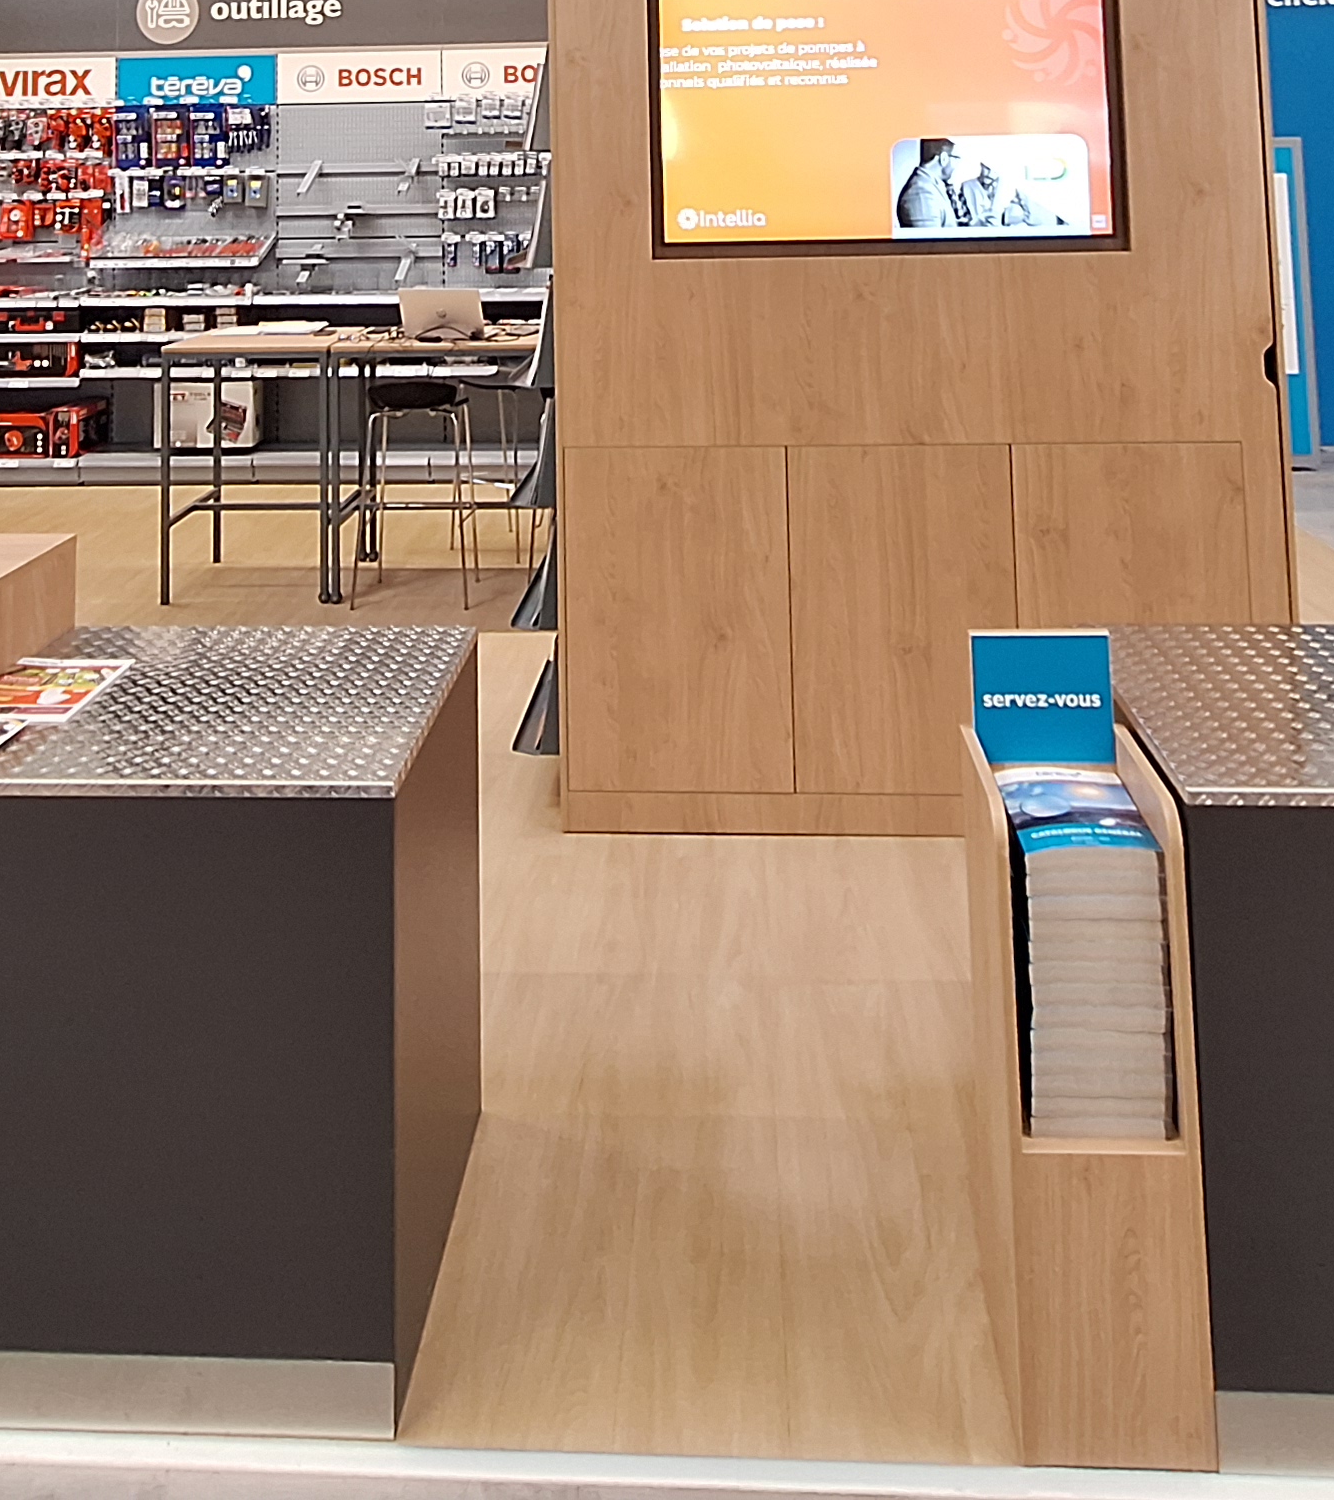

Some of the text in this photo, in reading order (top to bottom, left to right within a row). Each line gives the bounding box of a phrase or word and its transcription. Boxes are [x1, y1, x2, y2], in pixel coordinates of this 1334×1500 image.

[337, 66, 423, 88] BOSCH
[700, 209, 767, 228] Intellia
[982, 691, 1102, 708] servez-vous
